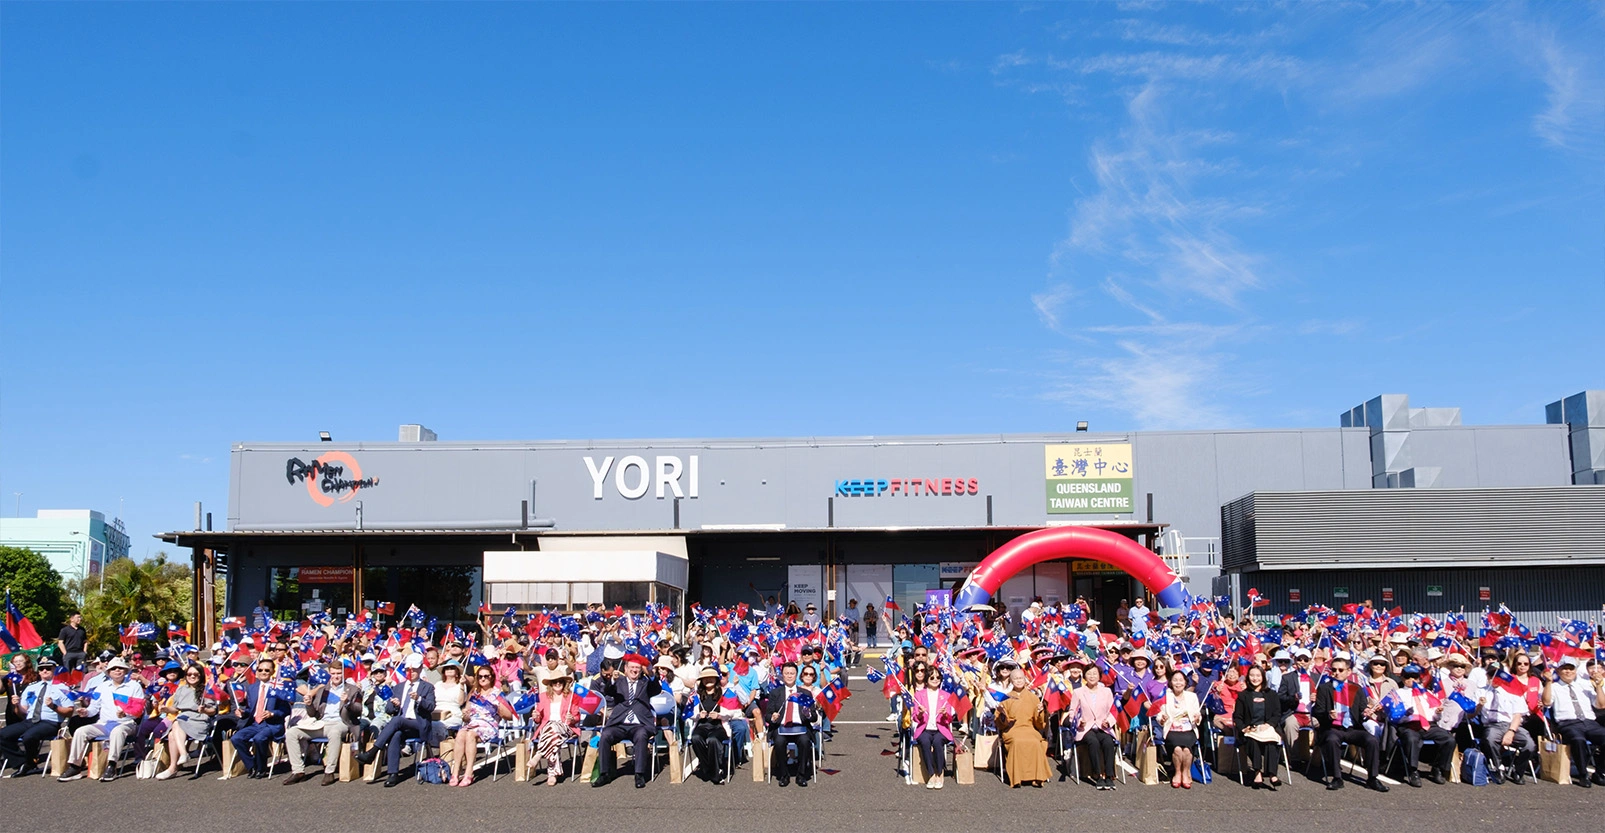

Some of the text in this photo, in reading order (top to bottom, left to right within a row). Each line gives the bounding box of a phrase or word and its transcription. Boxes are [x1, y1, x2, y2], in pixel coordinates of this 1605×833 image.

[1052, 457, 1129, 477] 臺灣中心
[582, 455, 699, 500] YORI
[1056, 483, 1122, 495] QUEENSLAND
[1050, 497, 1130, 509] TAIWAN CENTRE
